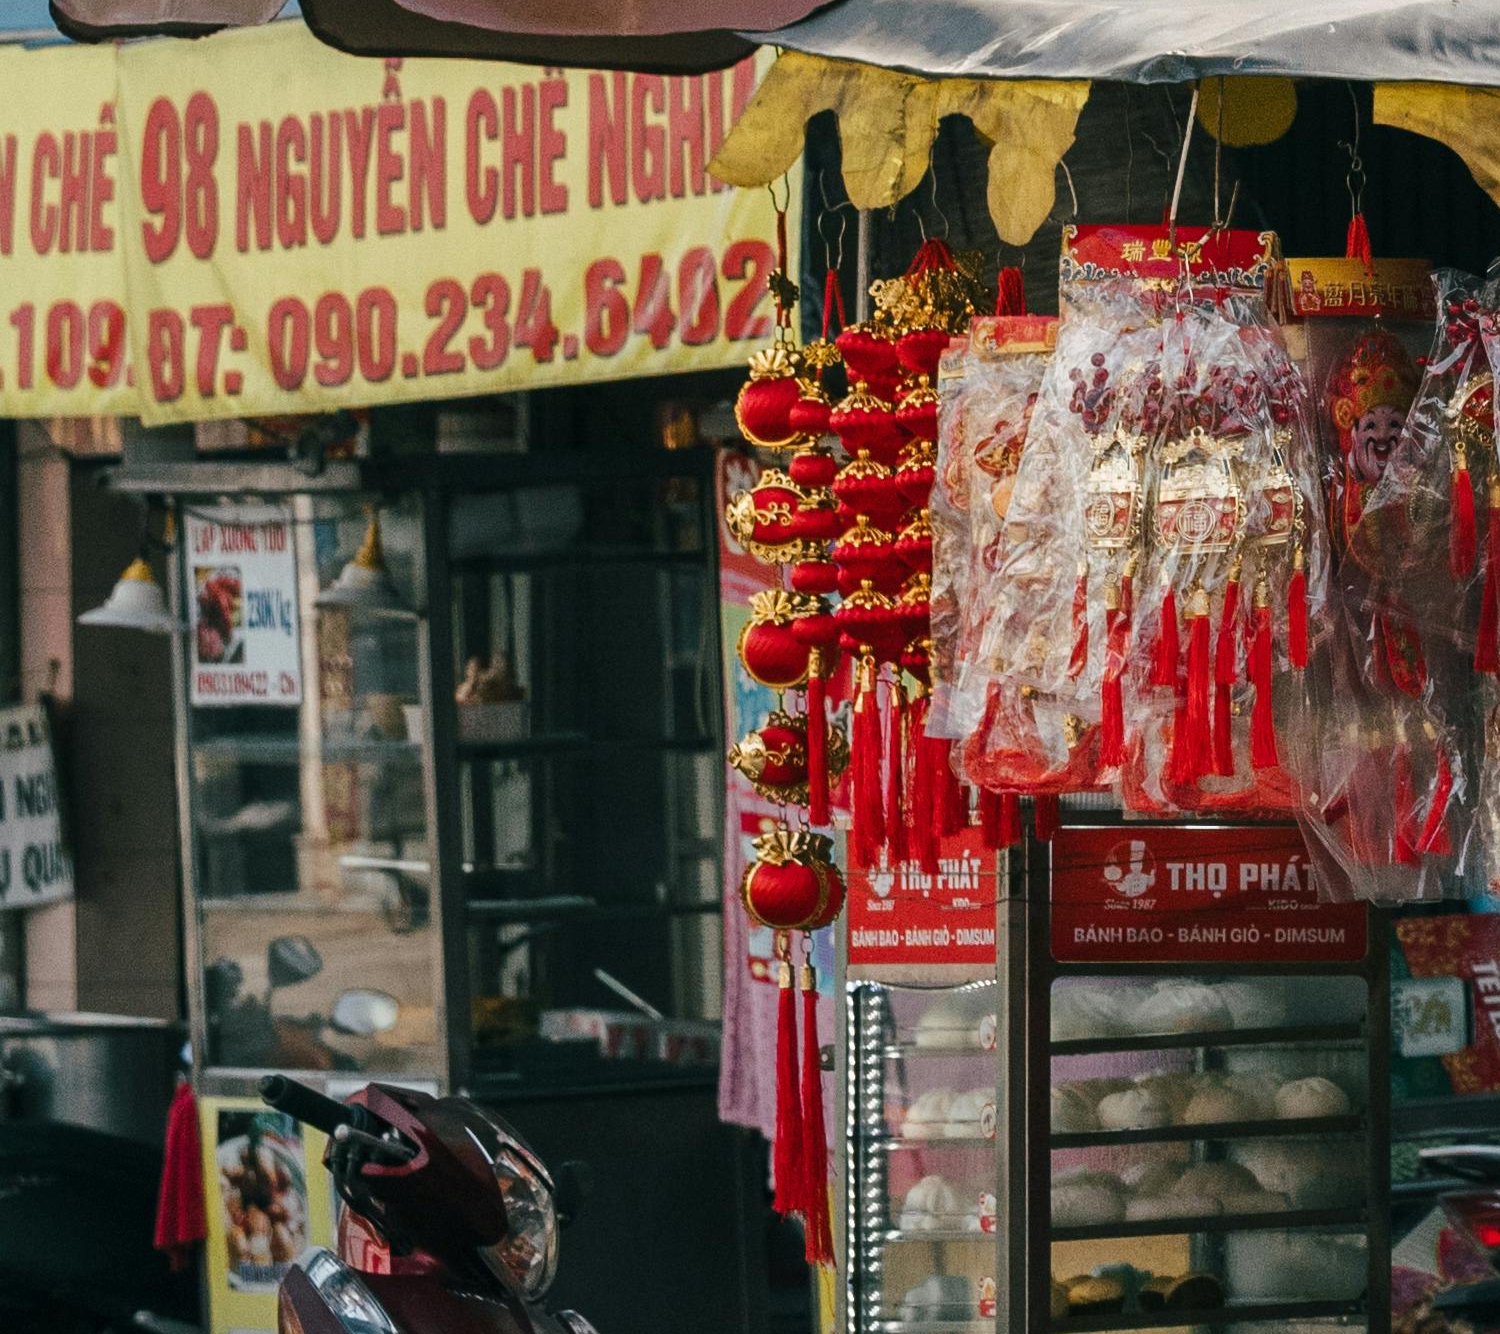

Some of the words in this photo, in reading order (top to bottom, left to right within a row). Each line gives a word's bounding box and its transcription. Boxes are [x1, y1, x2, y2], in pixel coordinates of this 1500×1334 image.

[138, 91, 221, 265] 98
[147, 304, 248, 404] ĐT:
[1166, 862, 1228, 899] THỌ
[1239, 854, 1319, 892] PHÁT
[1131, 898, 1157, 911] 1987
[955, 928, 995, 946] DIMSUM
[1074, 923, 1123, 943] BÁNH
[1126, 927, 1164, 943] BAO
[1178, 923, 1227, 943] BÁNH
[1274, 927, 1346, 944] DIMSUM
